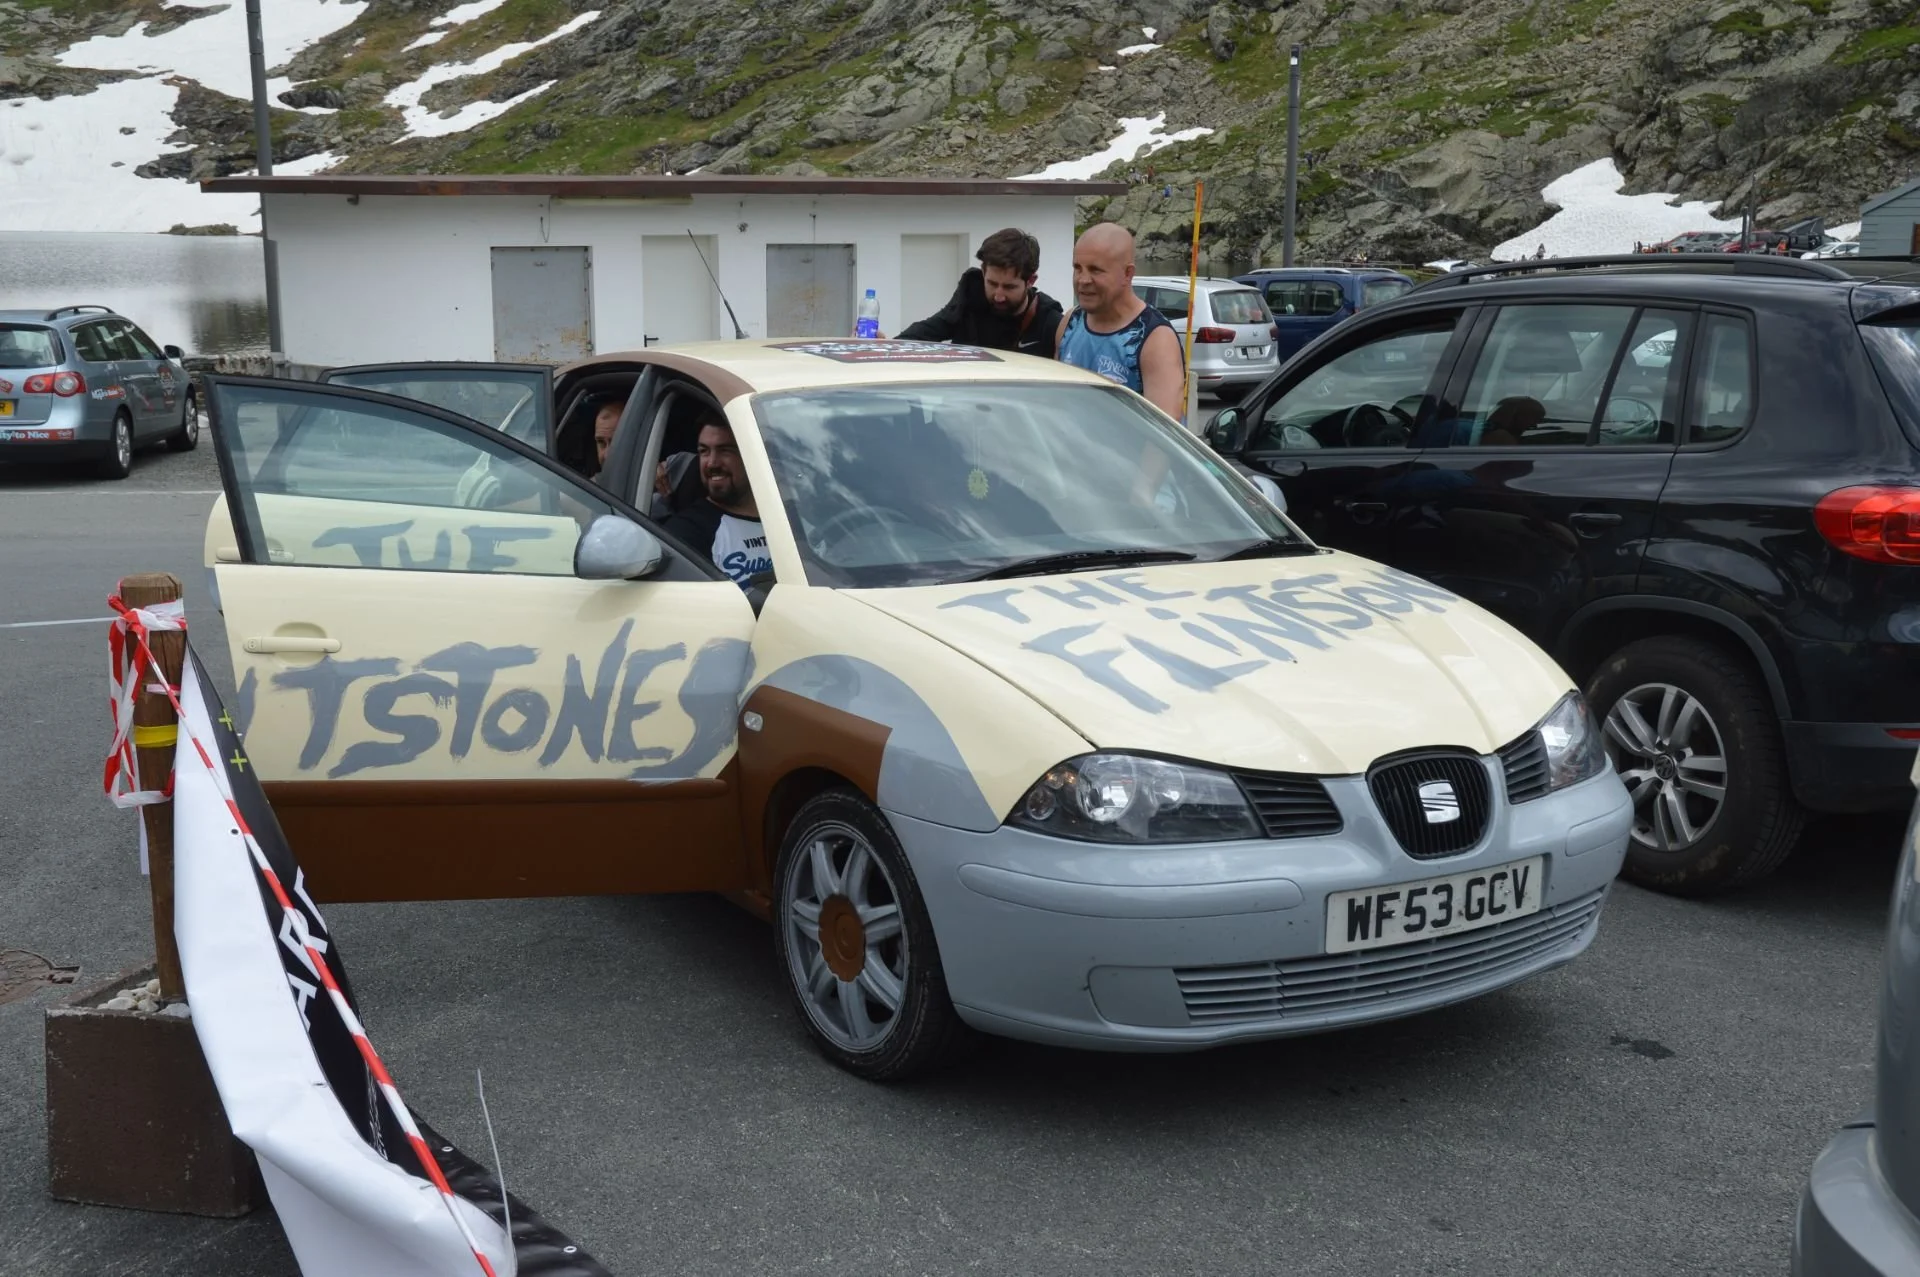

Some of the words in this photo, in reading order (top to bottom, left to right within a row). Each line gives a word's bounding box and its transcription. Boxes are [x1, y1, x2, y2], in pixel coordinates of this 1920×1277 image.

[27, 430, 50, 440] Nice
[937, 572, 1196, 625] THE
[1347, 883, 1454, 942] WF53
[1464, 865, 1530, 922] GCV
